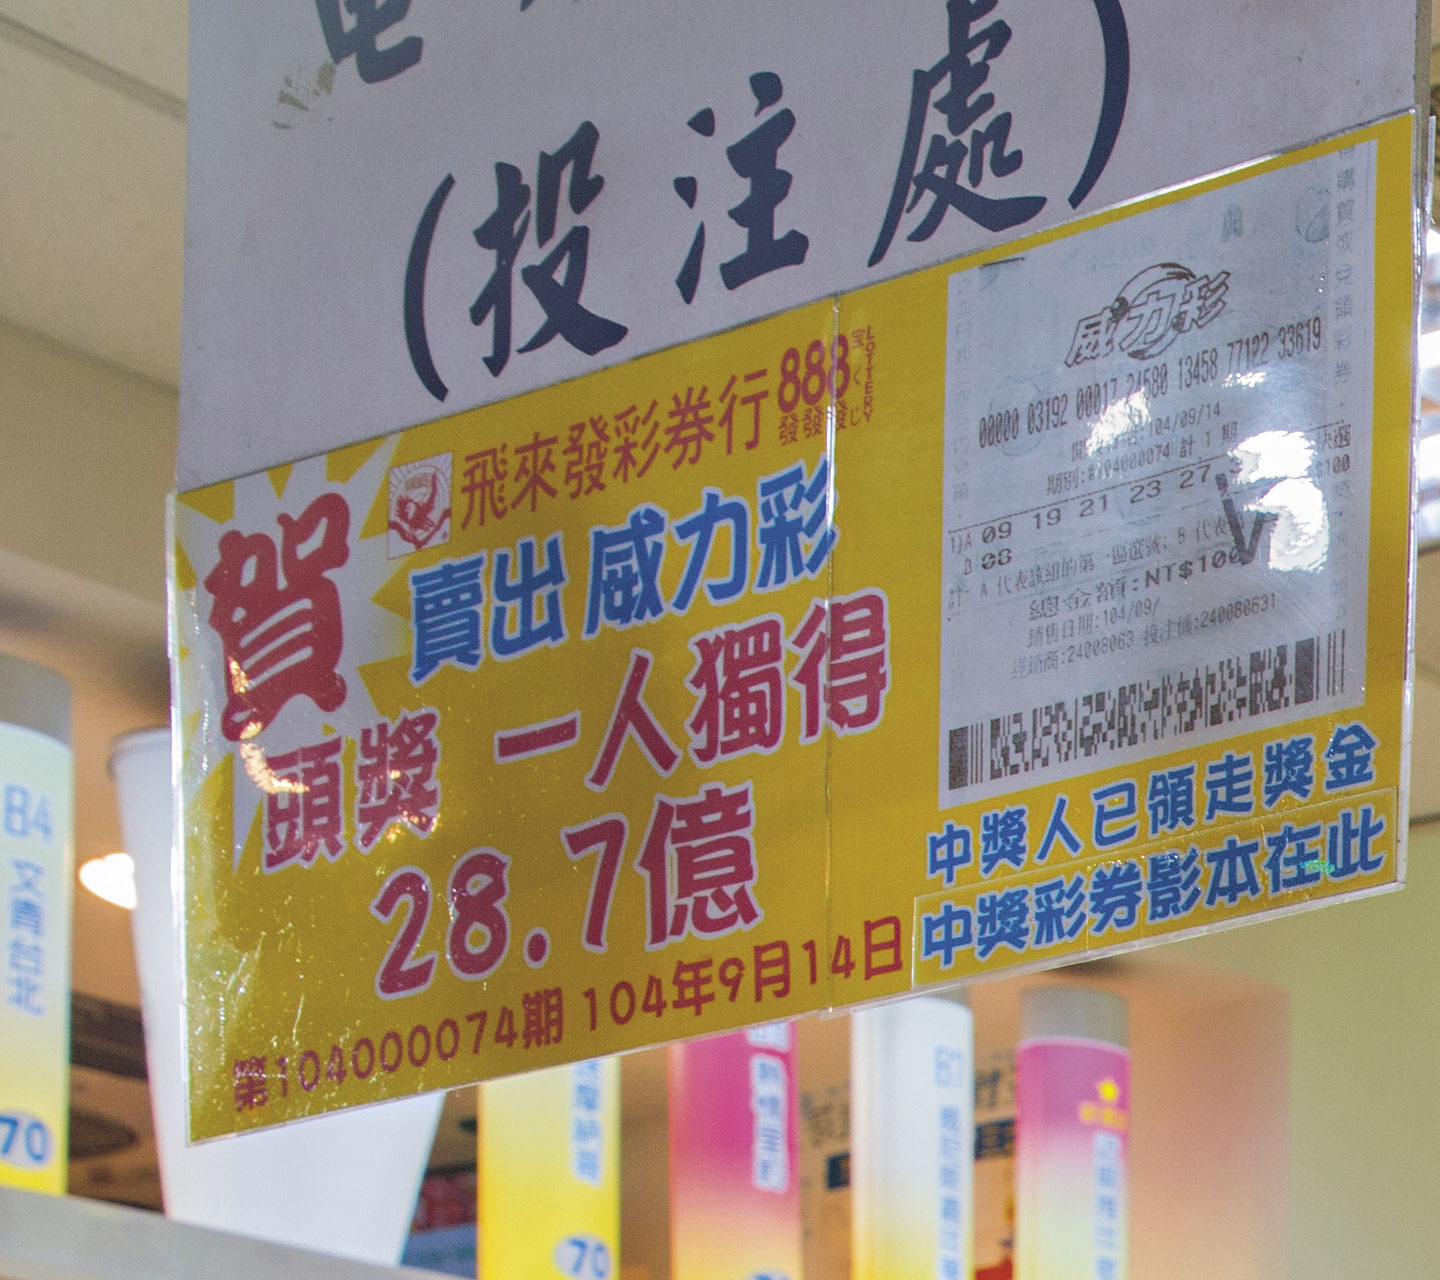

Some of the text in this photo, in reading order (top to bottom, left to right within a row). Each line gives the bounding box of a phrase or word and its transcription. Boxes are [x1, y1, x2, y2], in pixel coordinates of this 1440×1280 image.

[401, 0, 1131, 401] (投注處)
[982, 464, 1211, 543] 09 19 21 23 27
[205, 492, 352, 741] 賀
[918, 803, 1390, 970] 中獎彩券影本在此
[926, 722, 1378, 888] 中獎人已領走獎金
[369, 795, 764, 1000] 28.7億
[582, 917, 906, 1033] 104年9月14日
